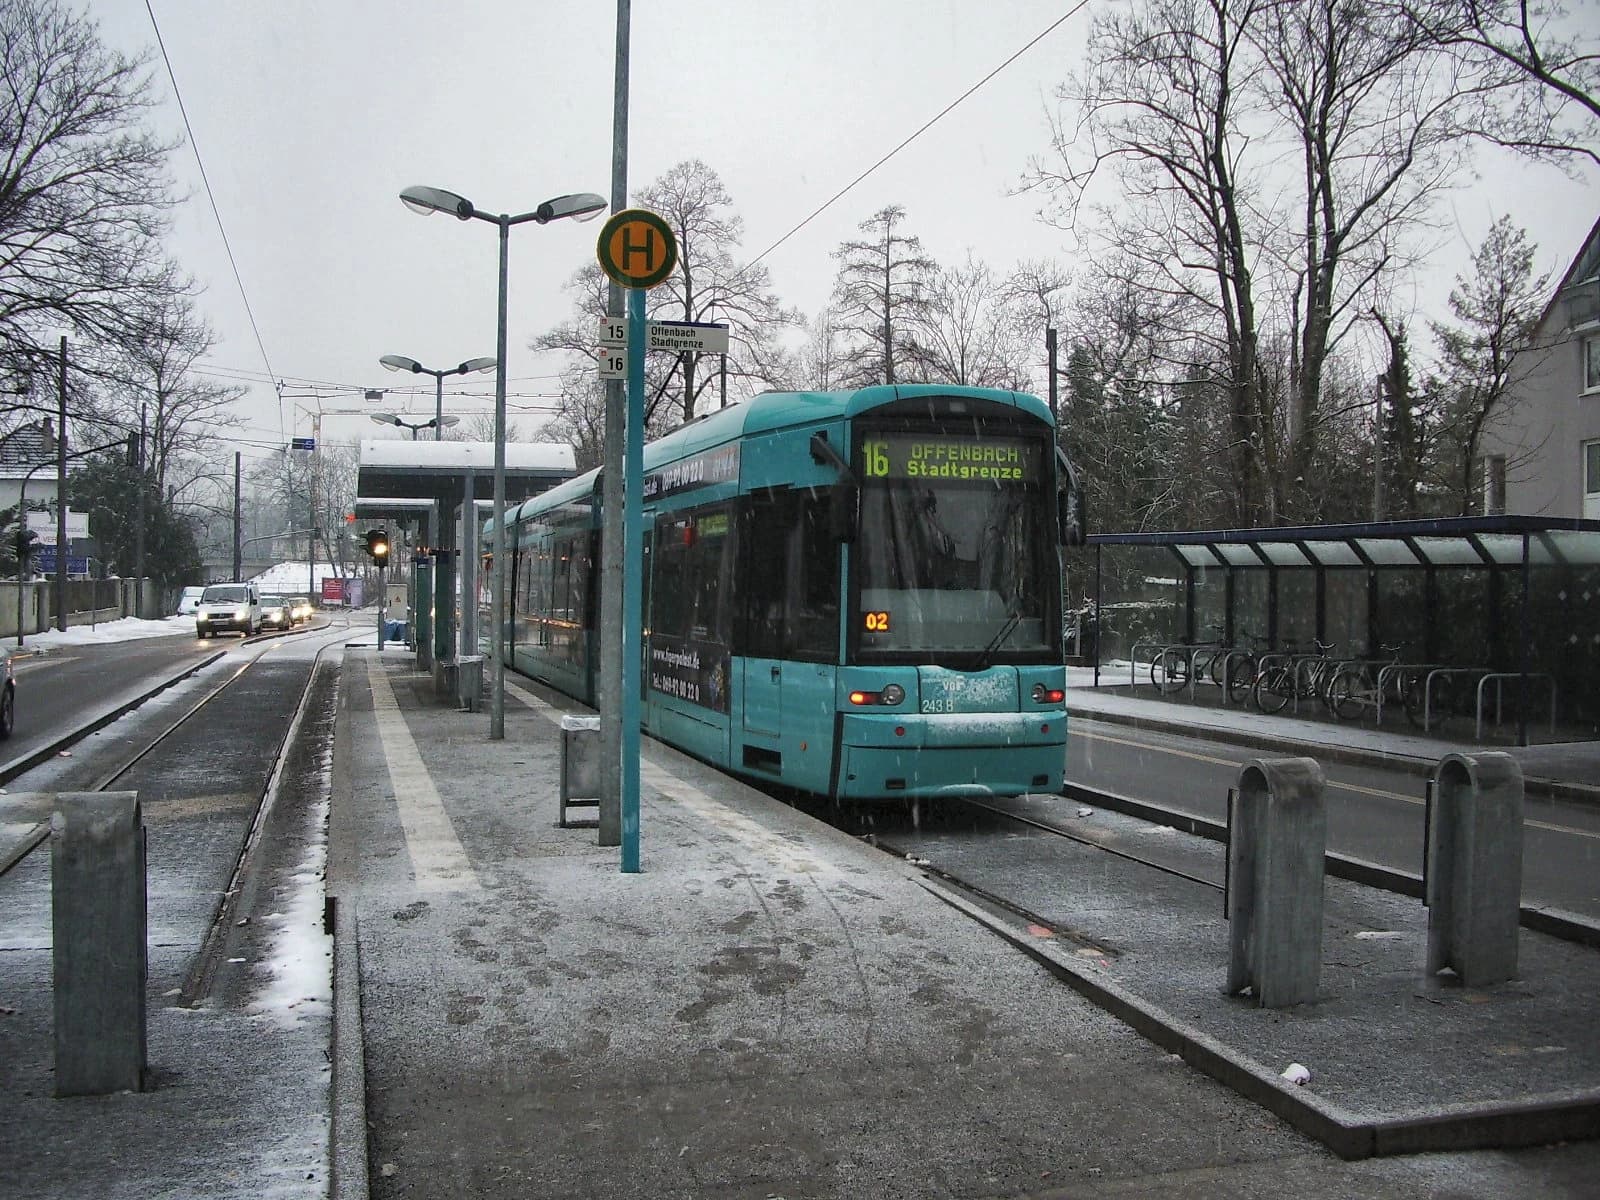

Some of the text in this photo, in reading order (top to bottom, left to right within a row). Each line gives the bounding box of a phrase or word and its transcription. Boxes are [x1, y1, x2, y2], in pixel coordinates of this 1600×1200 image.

[622, 227, 654, 271] H
[607, 325, 624, 339] 15
[651, 327, 696, 338] Offenbach
[651, 337, 704, 349] Stadtgrenze
[607, 357, 624, 371] 16
[862, 441, 1018, 478] 16 OFFENBACH
[908, 461, 1023, 479] Stadtgrenze
[865, 612, 889, 631] 02
